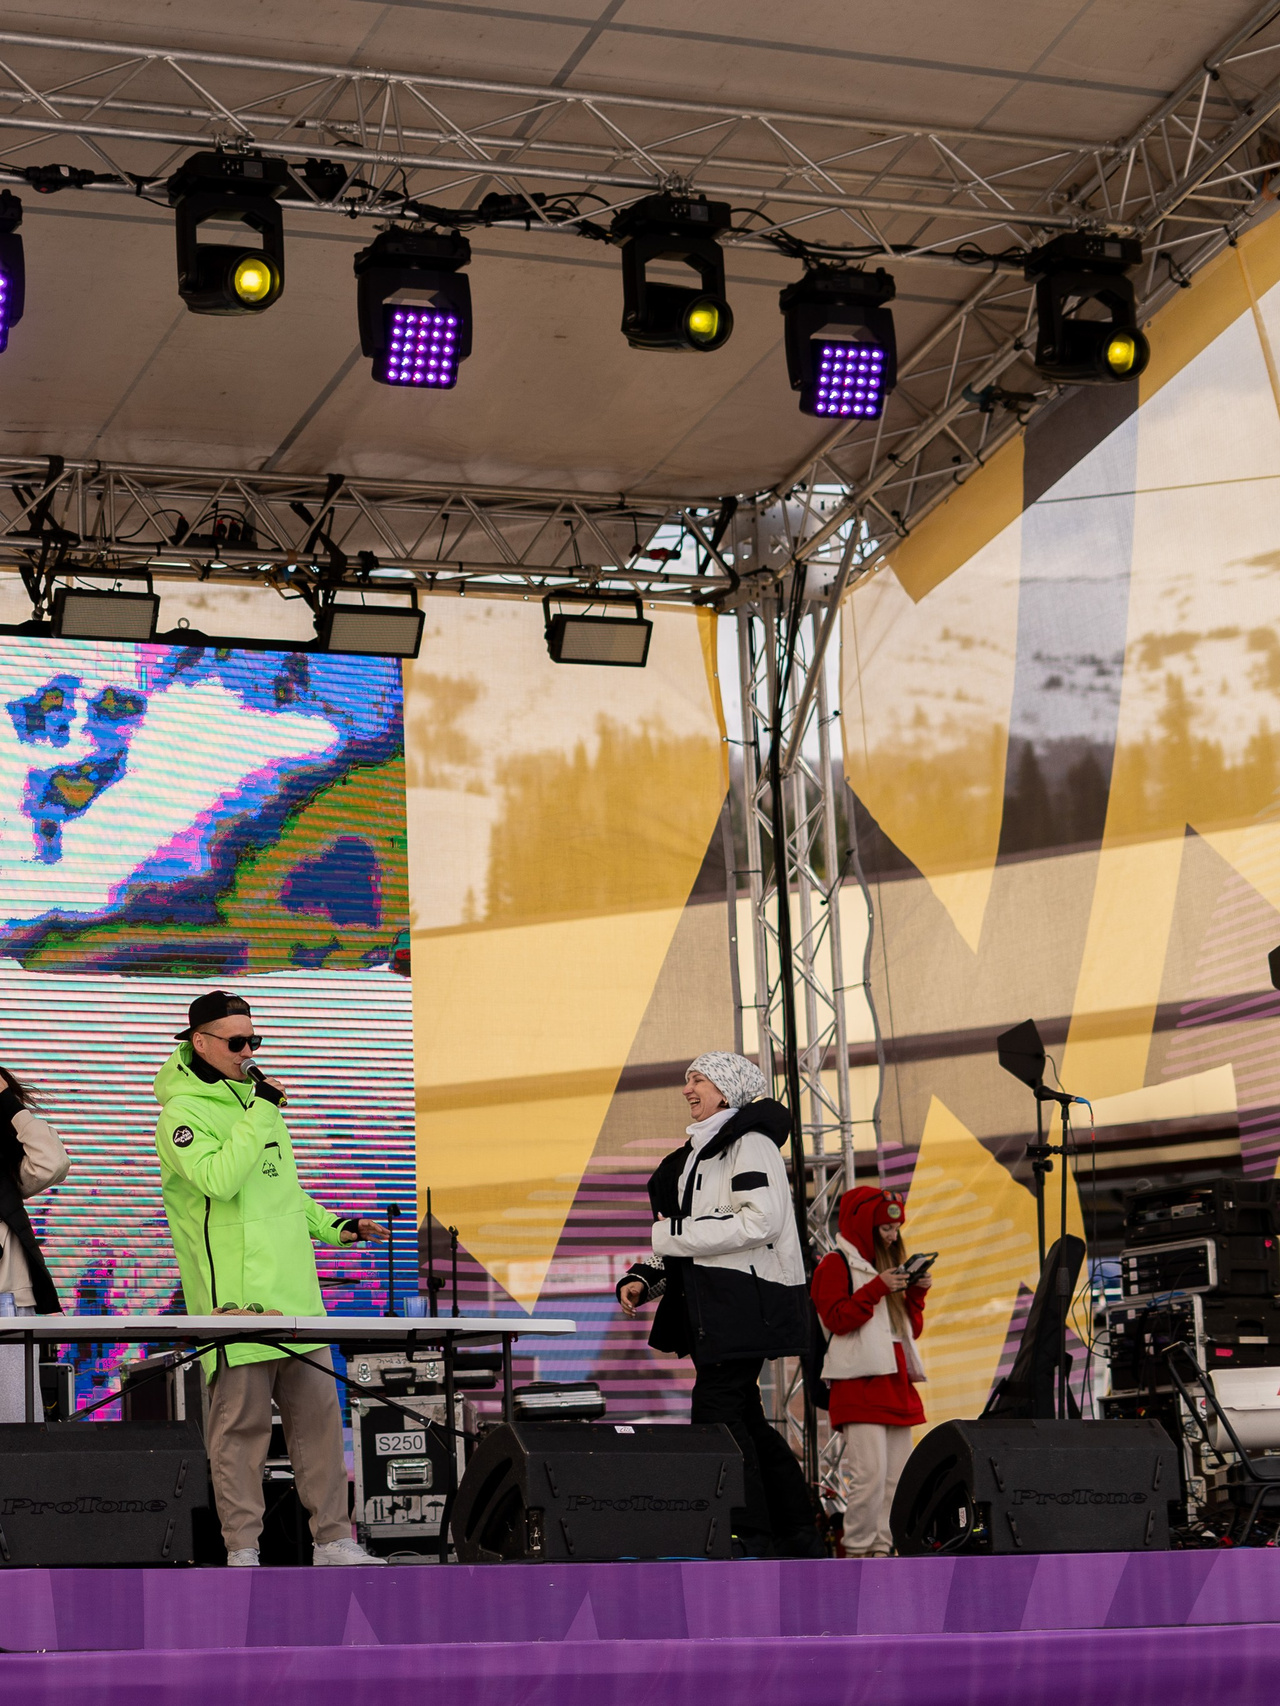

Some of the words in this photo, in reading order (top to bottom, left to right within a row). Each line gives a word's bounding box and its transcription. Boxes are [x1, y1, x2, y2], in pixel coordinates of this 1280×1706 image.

[378, 1435, 423, 1451] S250
[566, 1495, 710, 1511] ProTone
[1011, 1489, 1148, 1505] ProTone
[1, 1496, 168, 1515] ProTone
